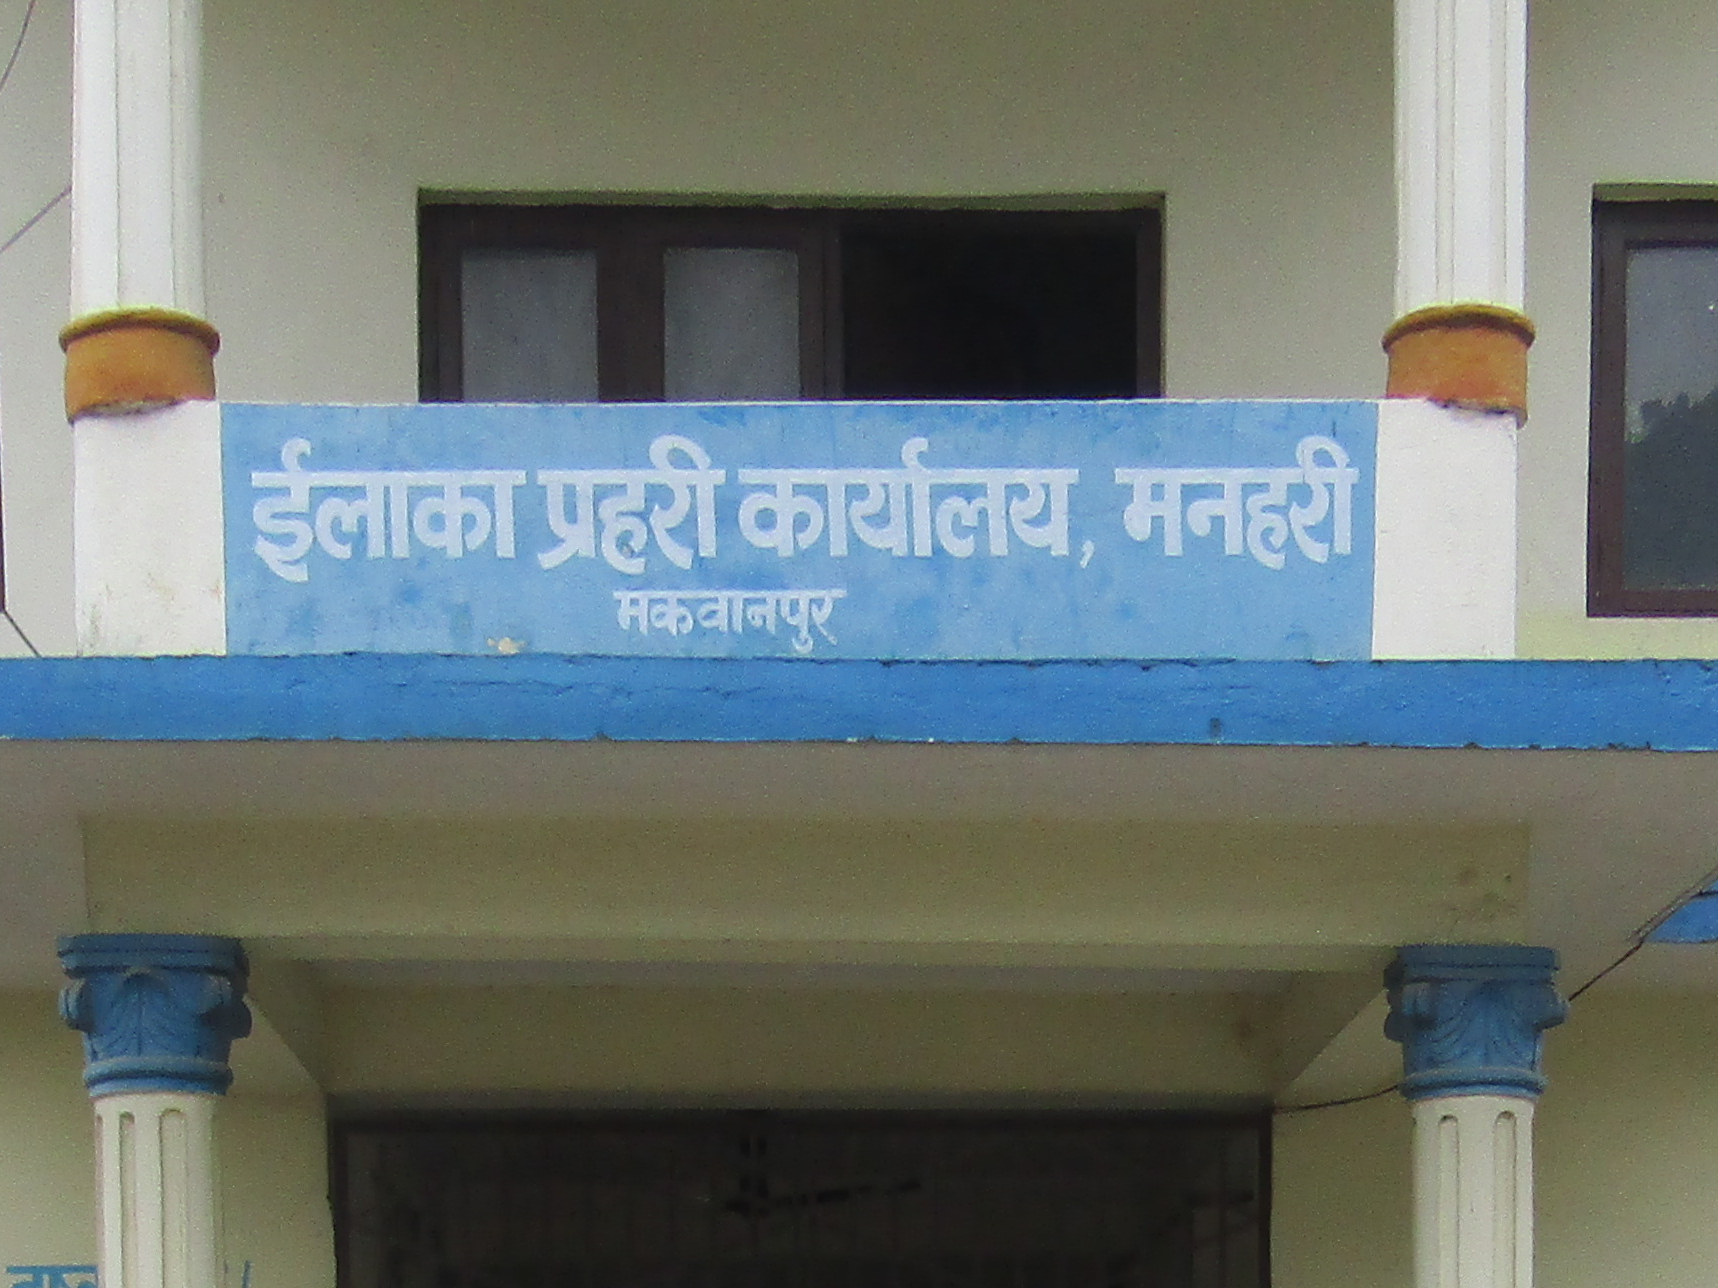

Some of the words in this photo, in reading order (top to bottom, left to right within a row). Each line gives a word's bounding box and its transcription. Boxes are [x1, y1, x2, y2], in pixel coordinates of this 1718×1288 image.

[251, 437, 527, 583] ईलाका
[537, 434, 726, 575] प्रहरी
[737, 437, 1095, 569] कार्यालय,
[1115, 435, 1360, 570] मनहरी
[613, 588, 847, 654] मकवानपुर
